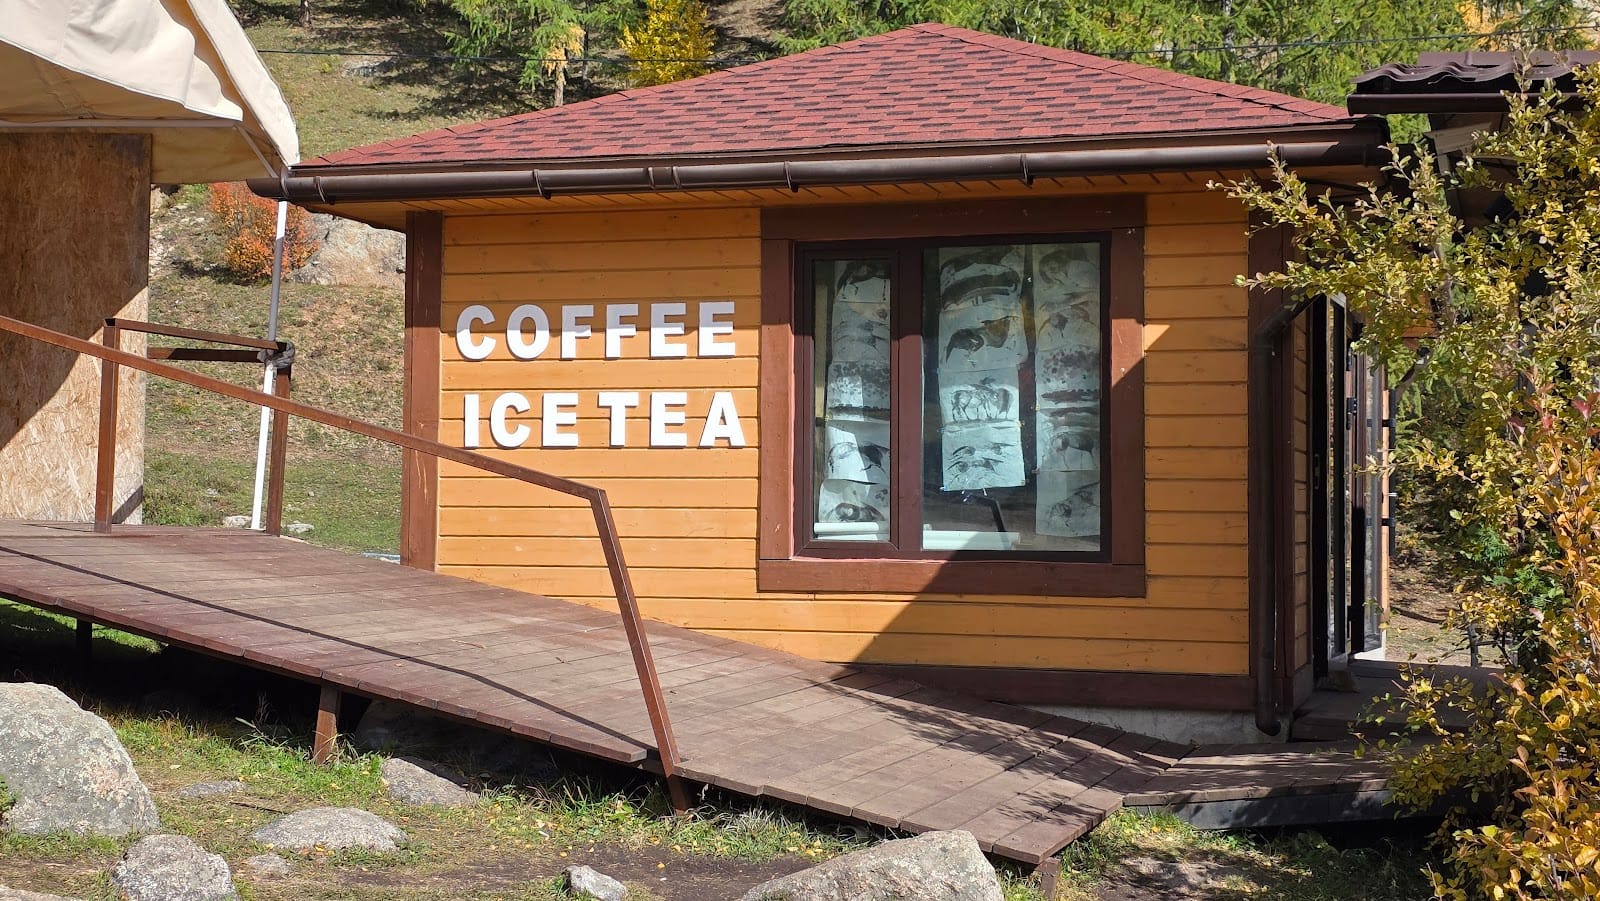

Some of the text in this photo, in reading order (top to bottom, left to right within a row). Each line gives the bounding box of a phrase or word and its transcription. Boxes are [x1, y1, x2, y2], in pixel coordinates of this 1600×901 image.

[456, 301, 736, 360] COFFEE
[463, 391, 746, 449] ICE TEA
